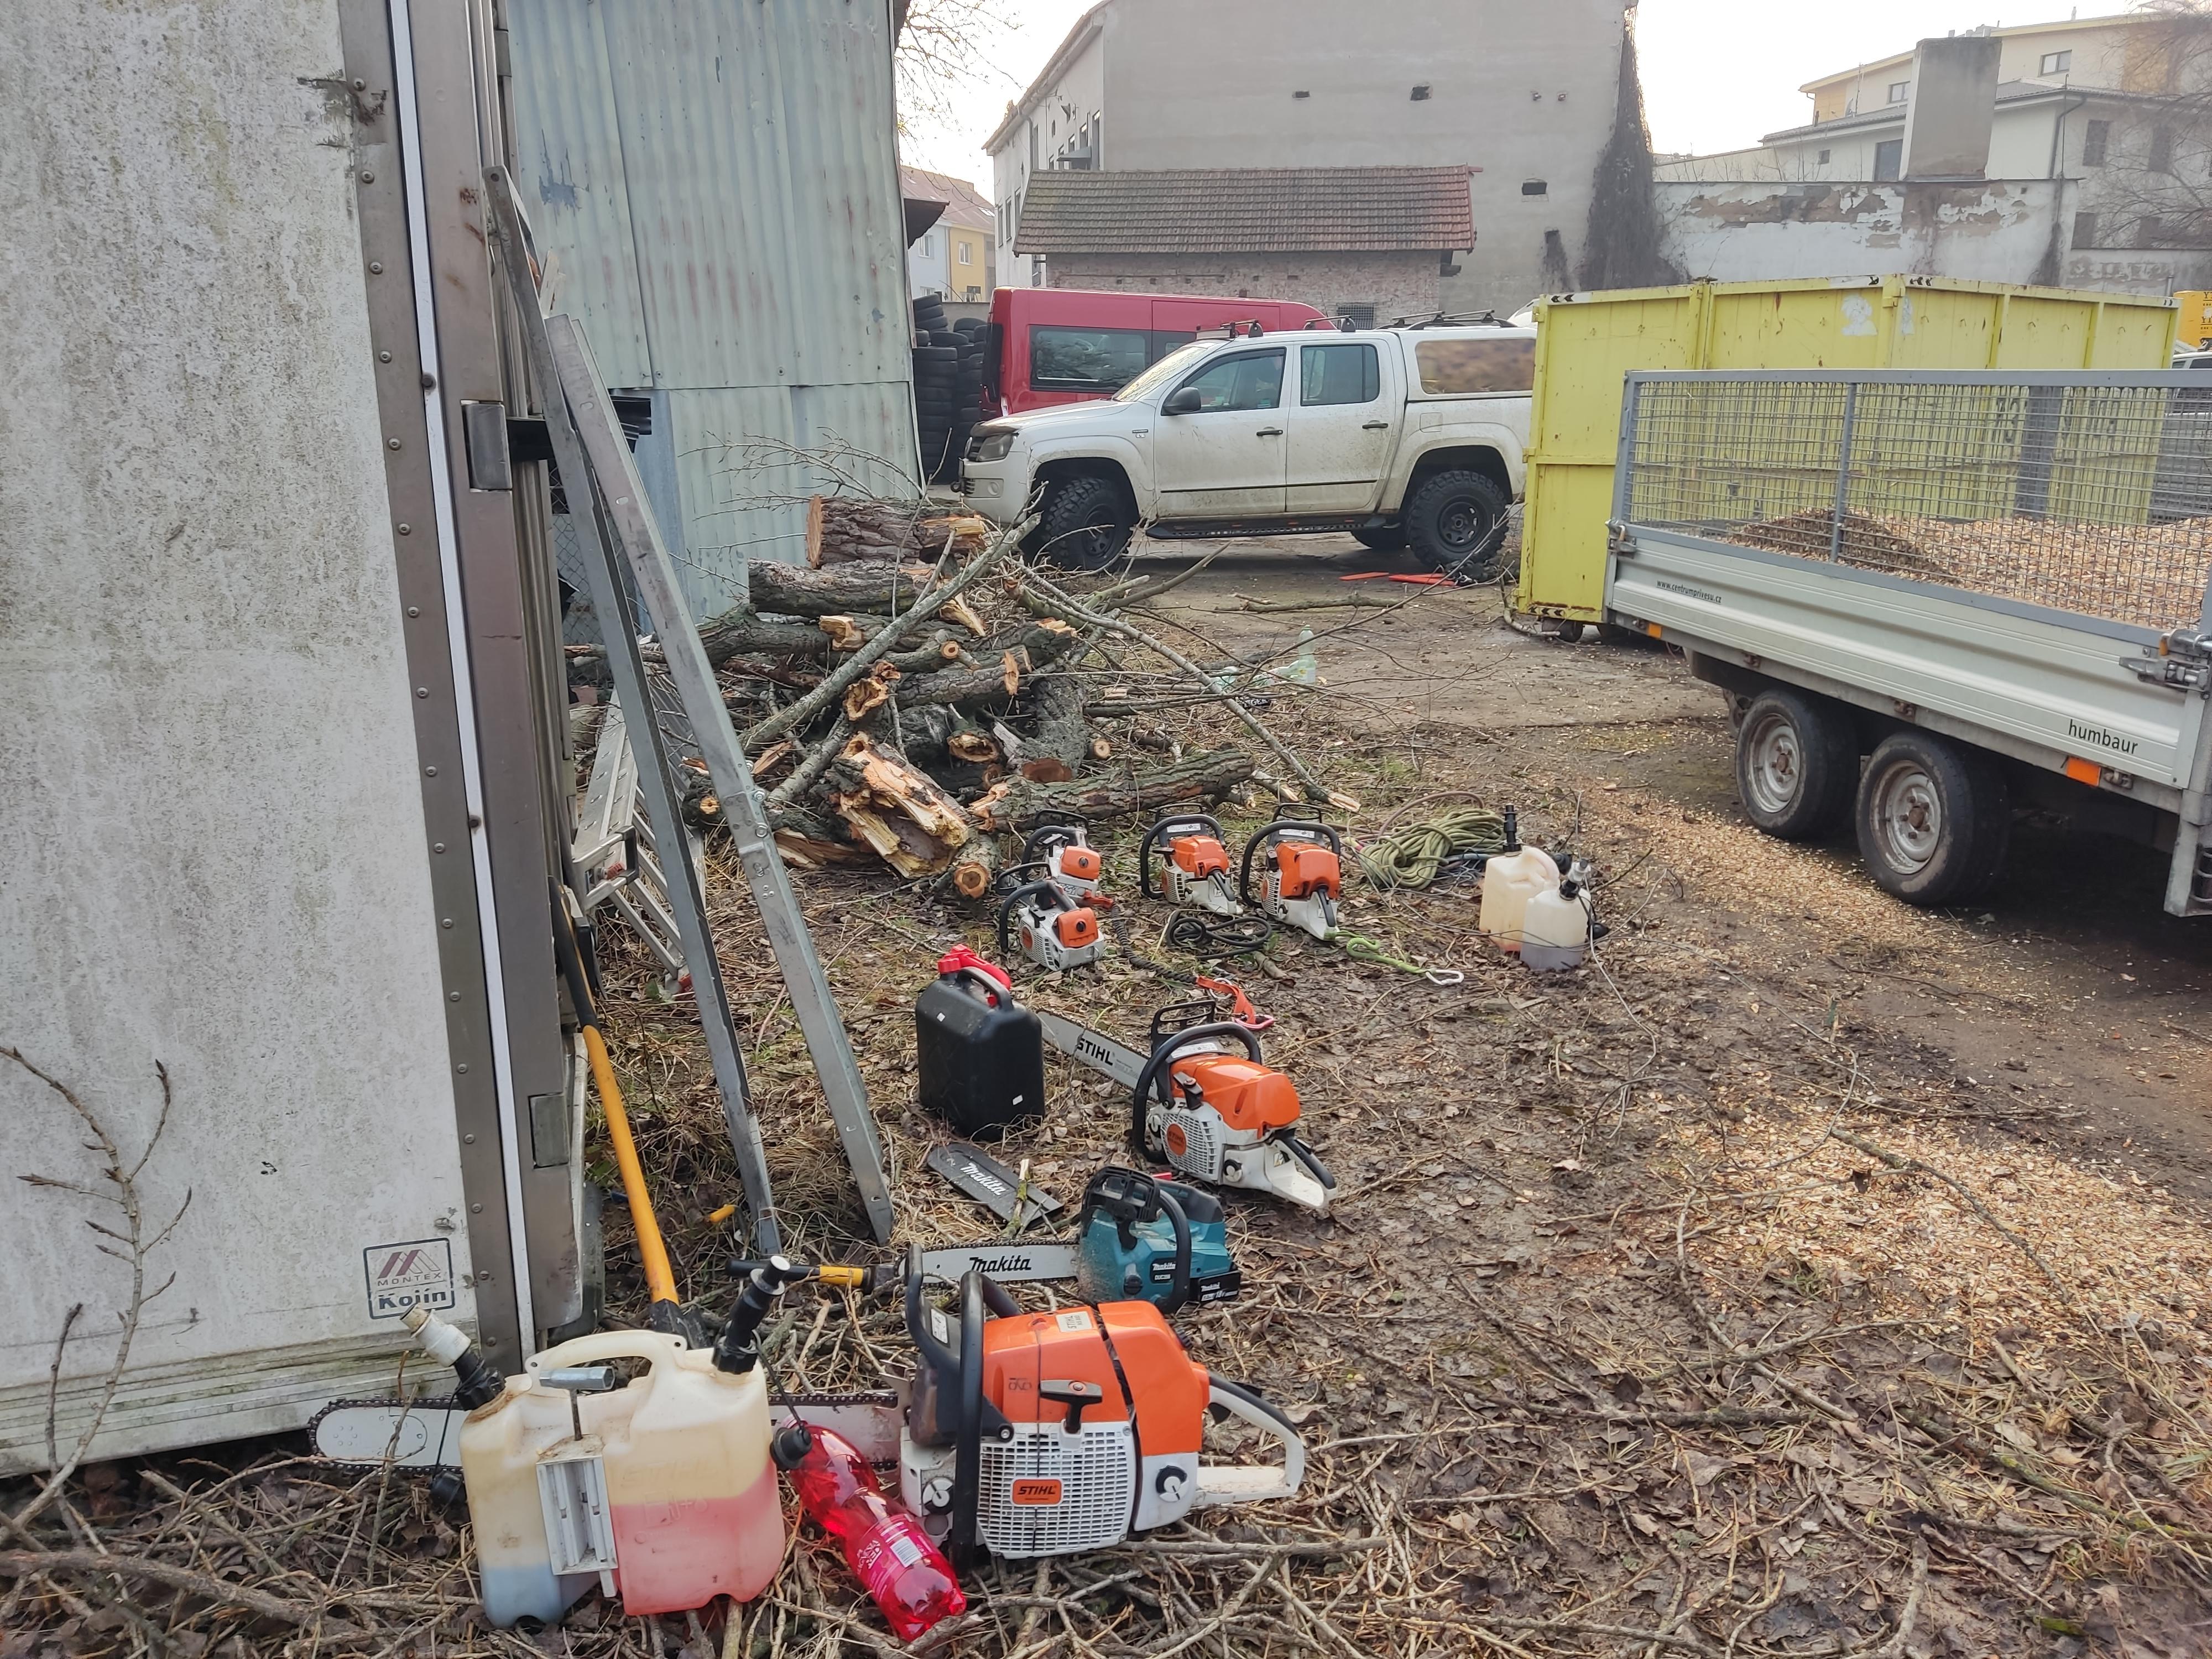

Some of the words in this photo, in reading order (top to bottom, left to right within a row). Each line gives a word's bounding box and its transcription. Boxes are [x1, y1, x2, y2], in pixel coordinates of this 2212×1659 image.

[1656, 580, 1721, 604] www.centrumprivesu.cz
[2068, 718, 2138, 754] humbaur
[1076, 1037, 1113, 1066] STIHL
[959, 1162, 1006, 1196] Makita
[969, 1254, 1032, 1273] Makita
[377, 1272, 441, 1286] MONTEX
[1018, 1485, 1056, 1495] STIHL
